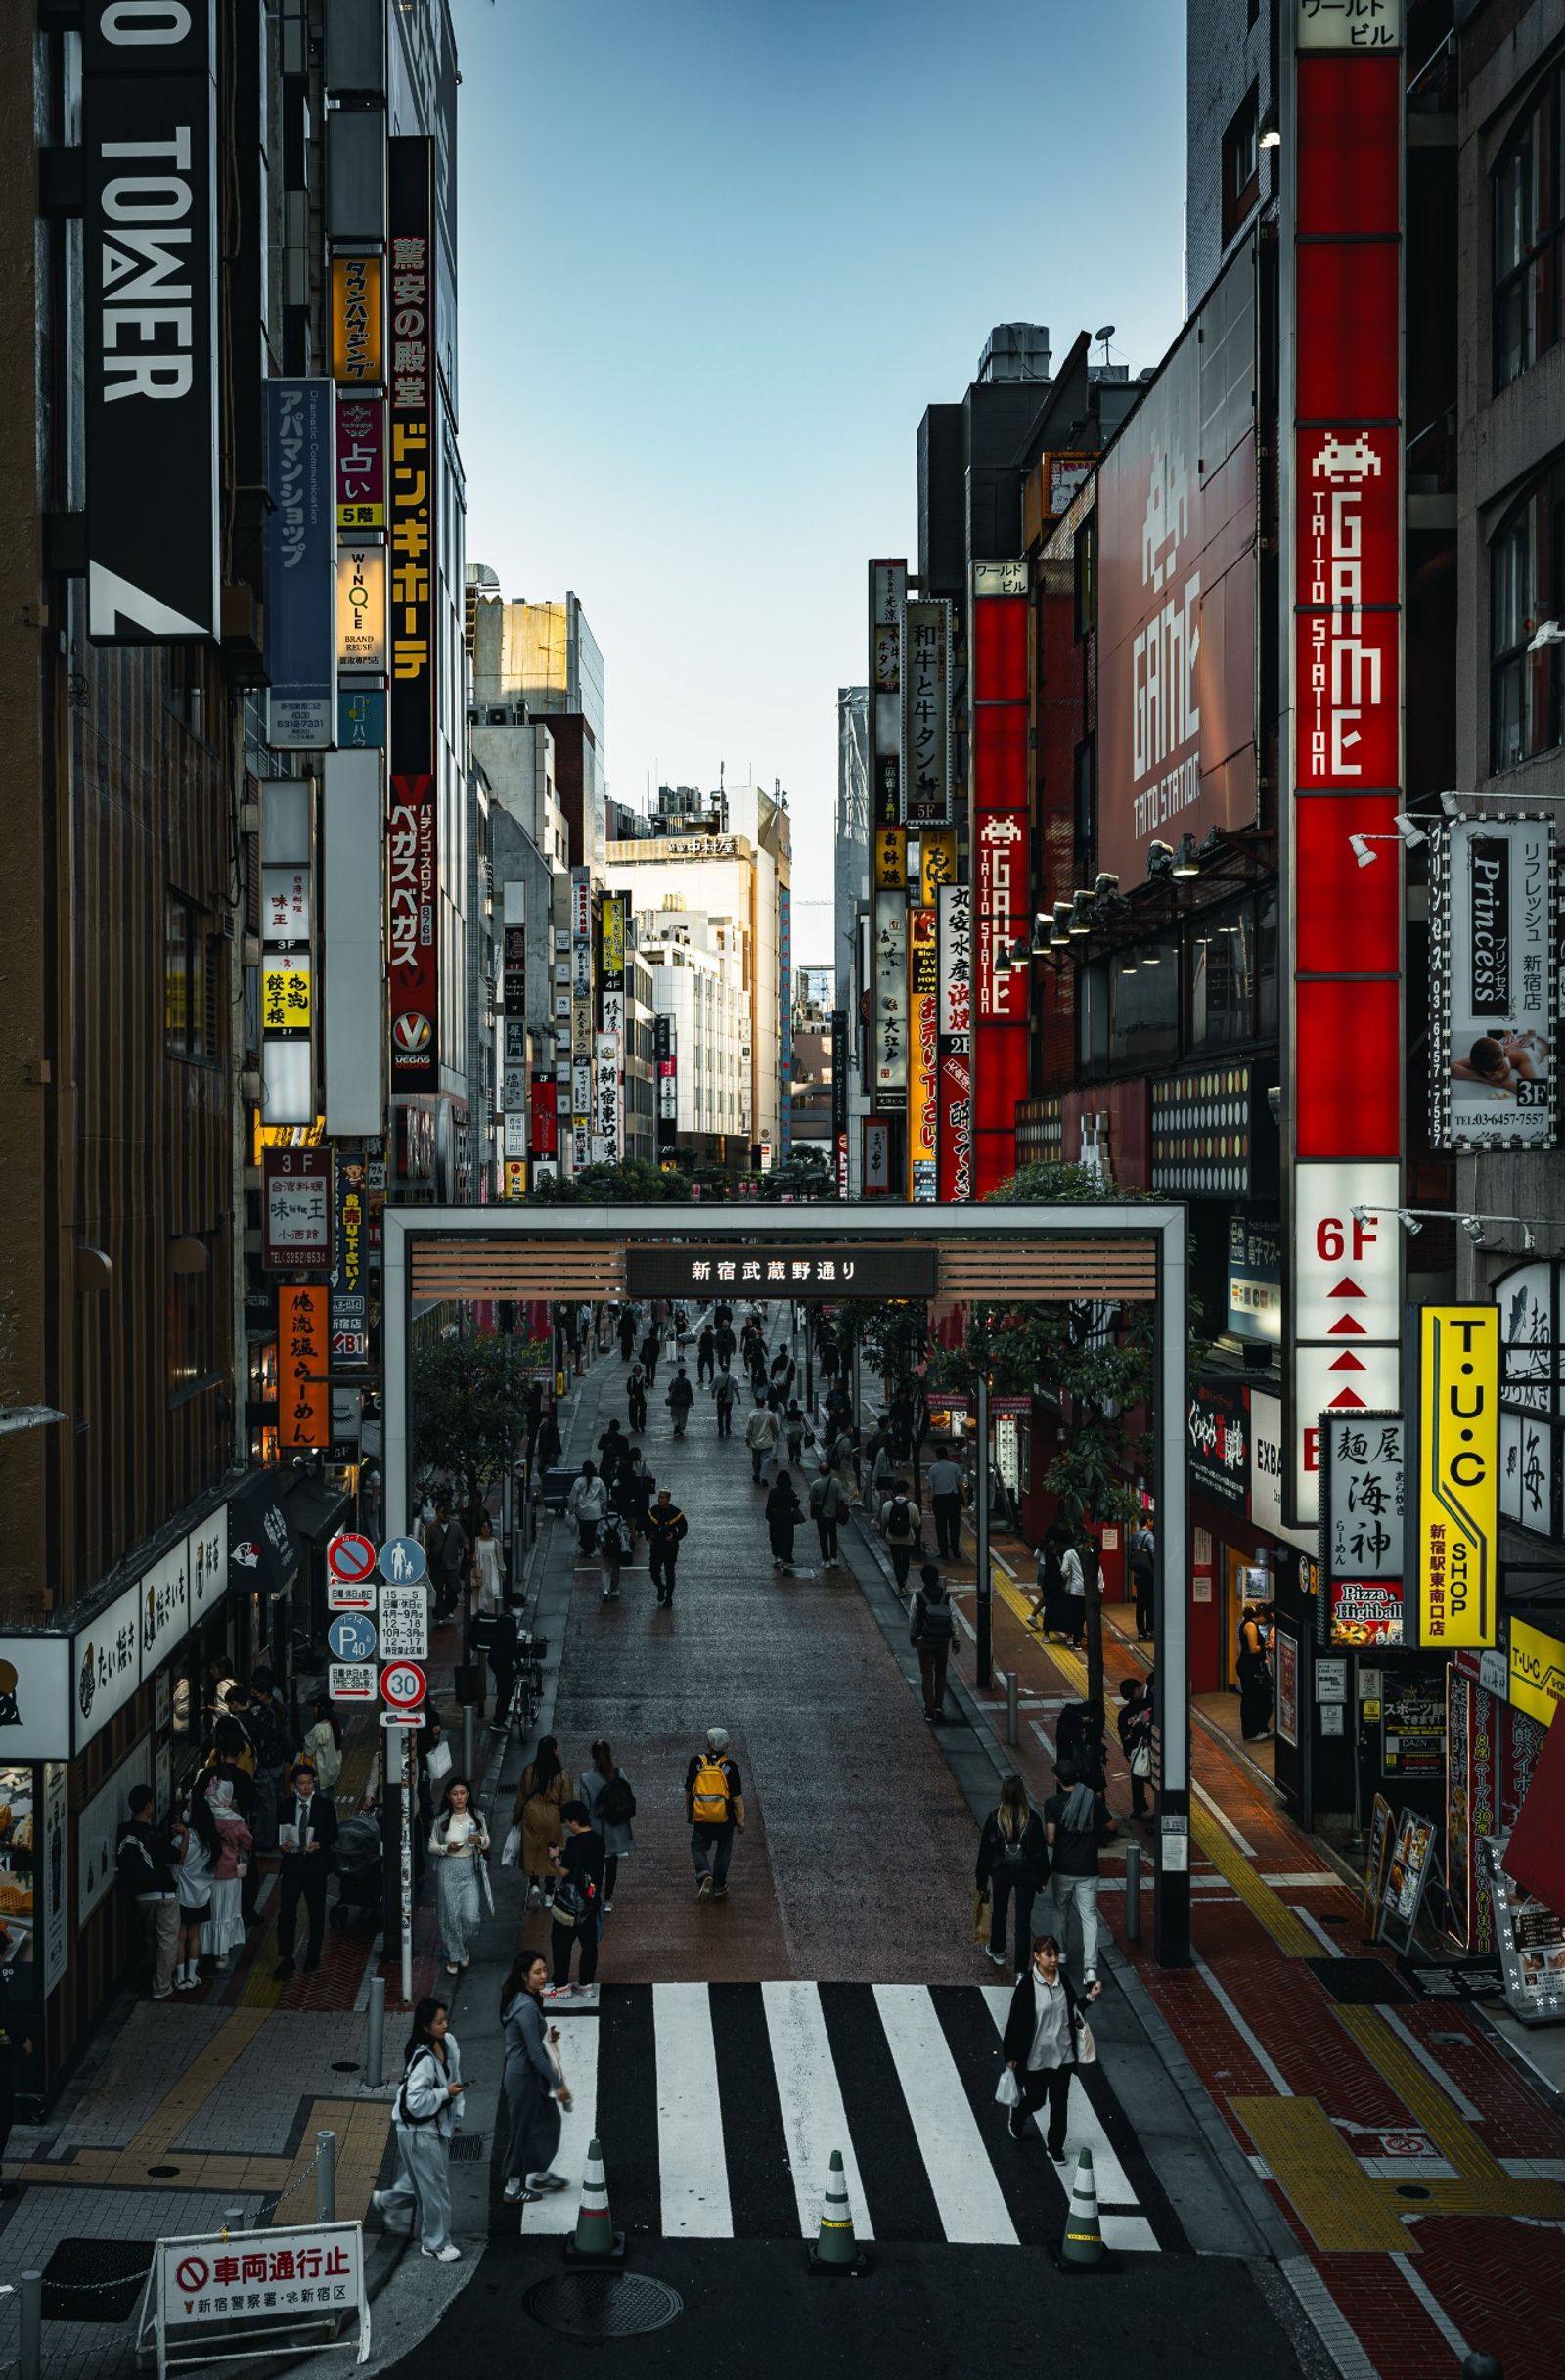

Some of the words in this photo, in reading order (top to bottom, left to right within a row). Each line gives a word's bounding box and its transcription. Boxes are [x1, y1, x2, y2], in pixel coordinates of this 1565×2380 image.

[1351, 25, 1394, 45] ビル
[101, 126, 193, 402] TOWER
[343, 260, 374, 379] タウンハウジング
[393, 238, 426, 409] 驚安の殿堂
[280, 391, 306, 568] アパマンショップ
[340, 442, 377, 500] 占い
[342, 507, 374, 523] 5階
[393, 423, 430, 679] ドン・キホーテ
[1312, 491, 1326, 604] TAITO
[975, 564, 1023, 577] ワールド
[1002, 581, 1026, 593] ビル
[344, 635, 374, 644] BRAND
[346, 643, 373, 651] REUSE
[1331, 491, 1382, 776] GAME
[1133, 570, 1201, 783] GAME
[1312, 618, 1326, 776] STATION
[917, 805, 936, 819] 5F
[1134, 782, 1160, 840] TAITO
[1160, 751, 1201, 822] STATION
[930, 832, 948, 844] 4F
[391, 806, 419, 966] ベガスベガス
[1431, 824, 1442, 971] プリンセス
[1525, 842, 1542, 942] リフレッシュ
[272, 894, 288, 926] 味王
[1474, 856, 1500, 1003] Princess
[278, 940, 296, 949] 3F
[1494, 936, 1508, 1000] プリンセス
[1523, 954, 1542, 1010] 新宿店
[884, 1016, 900, 1062] 大江戸
[1518, 1080, 1546, 1105] 3F
[272, 1181, 325, 1192] 台湾料理
[270, 1199, 289, 1220] 味
[306, 1199, 325, 1220] 王
[278, 1229, 320, 1240] 小酒館
[1317, 1217, 1378, 1261] 6F
[270, 1252, 326, 1264] TEL(3352)9534
[692, 1261, 856, 1280] 新宿武蔵野通り
[344, 1333, 364, 1354] B1
[290, 1290, 318, 1445] 俺流塩らーめん
[1338, 1427, 1403, 1465] 麺屋
[1395, 1471, 1405, 1516] あら炊き
[1348, 1471, 1392, 1570] 海神
[1335, 1520, 1346, 1566] らーめん
[385, 1591, 397, 1599] 15
[412, 1591, 419, 1599] 5
[1343, 1584, 1386, 1602] Pizza
[1430, 1524, 1447, 1637] 新宿駅東南口店
[1451, 1543, 1468, 1616] SHOP
[385, 1619, 396, 1628] 12
[409, 1619, 421, 1628] 18
[1337, 1601, 1402, 1622] Highball
[98, 1620, 135, 1690] たい焼き
[339, 1626, 357, 1655] P
[352, 1642, 365, 1656] 40
[385, 1638, 396, 1646] 12
[409, 1638, 421, 1646] 17
[391, 1674, 416, 1695] 30
[213, 2245, 350, 2287] 車両通行止
[300, 2285, 347, 2304] 新宿区
